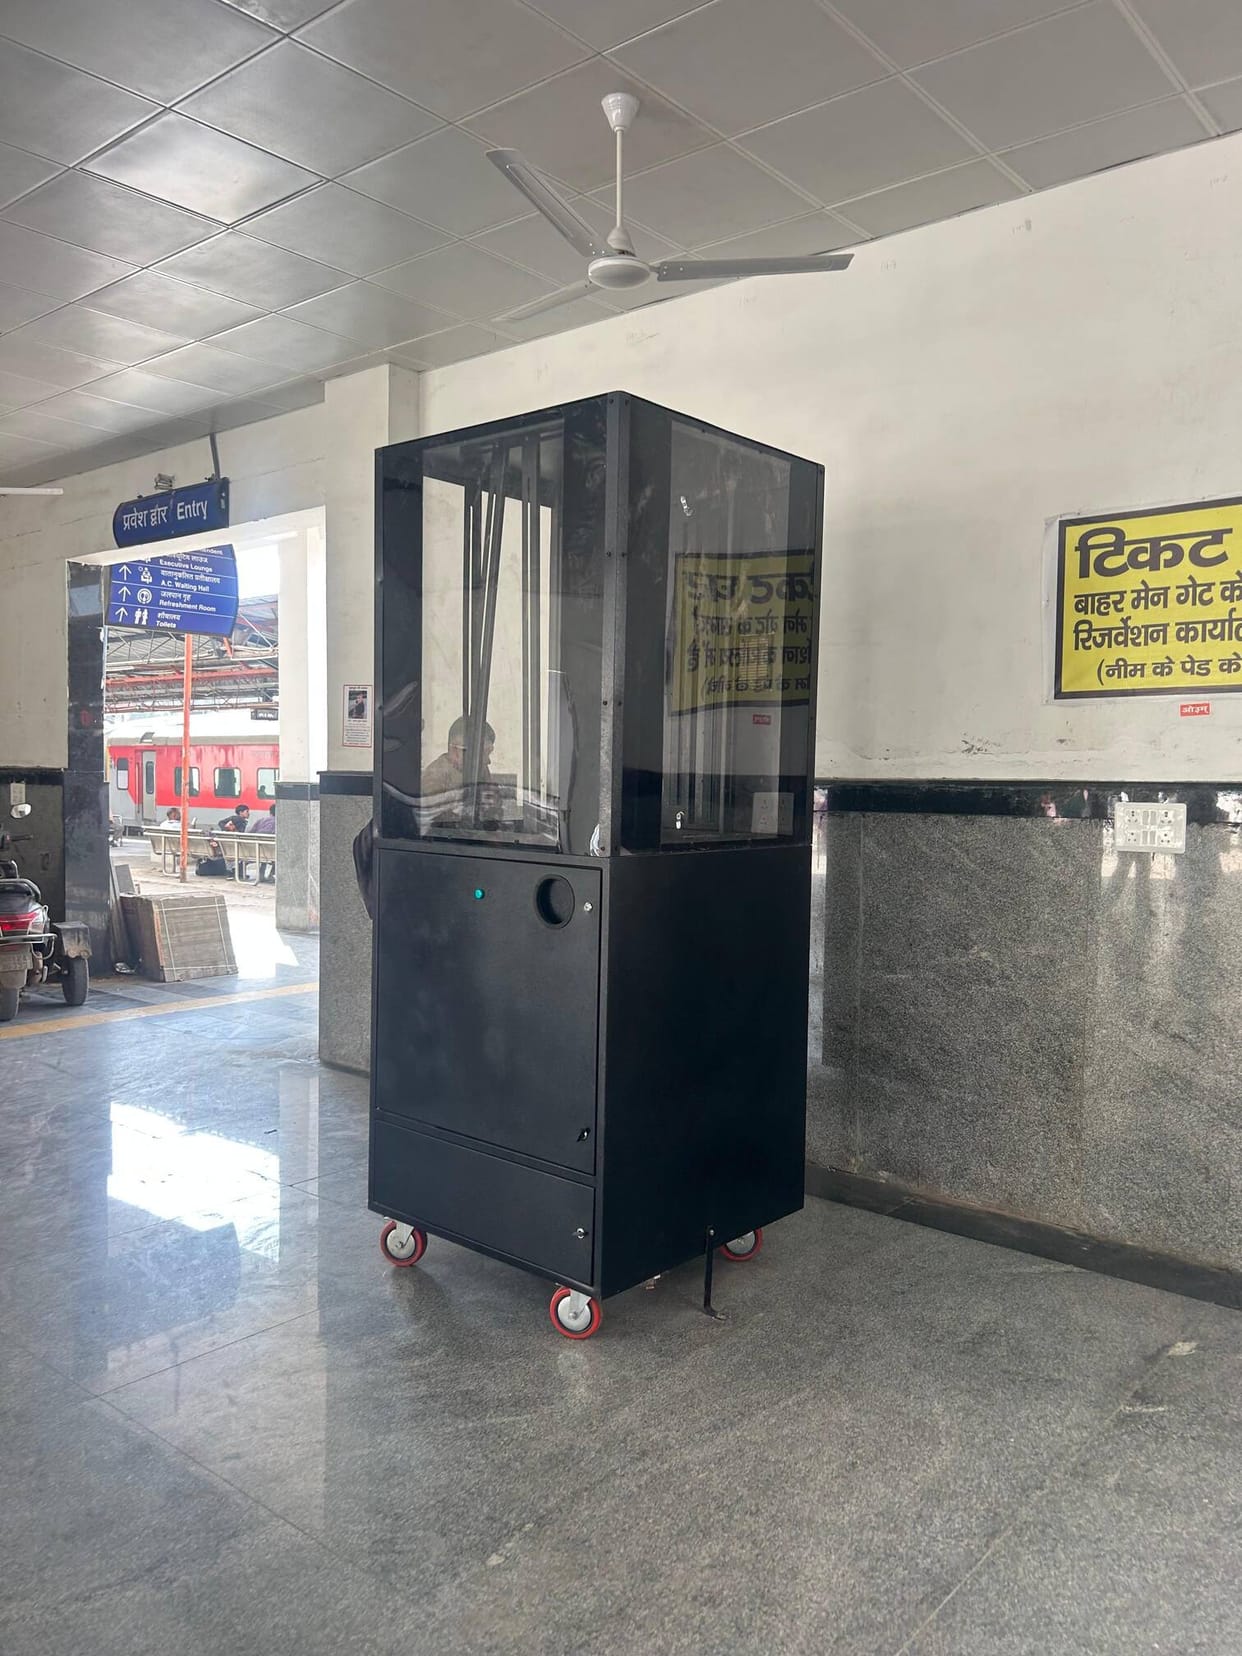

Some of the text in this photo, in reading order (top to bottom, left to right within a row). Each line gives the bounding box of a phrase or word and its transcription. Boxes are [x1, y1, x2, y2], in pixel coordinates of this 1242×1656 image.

[123, 507, 149, 531] प्रवेश
[177, 500, 208, 521] Entry
[1075, 526, 1233, 578] टिकट
[159, 558, 213, 573] Executive Lounge
[160, 579, 210, 593] A.C. Waiting Hall
[1074, 590, 1127, 616] बाहर
[1131, 579, 1171, 610] मेन
[1176, 574, 1216, 606] गेट
[159, 599, 217, 613] Refreshment Room
[155, 620, 177, 629] Toilets
[1073, 616, 1170, 651] रिजर्वेशन
[1097, 651, 1242, 686] (नीम के पेड के
